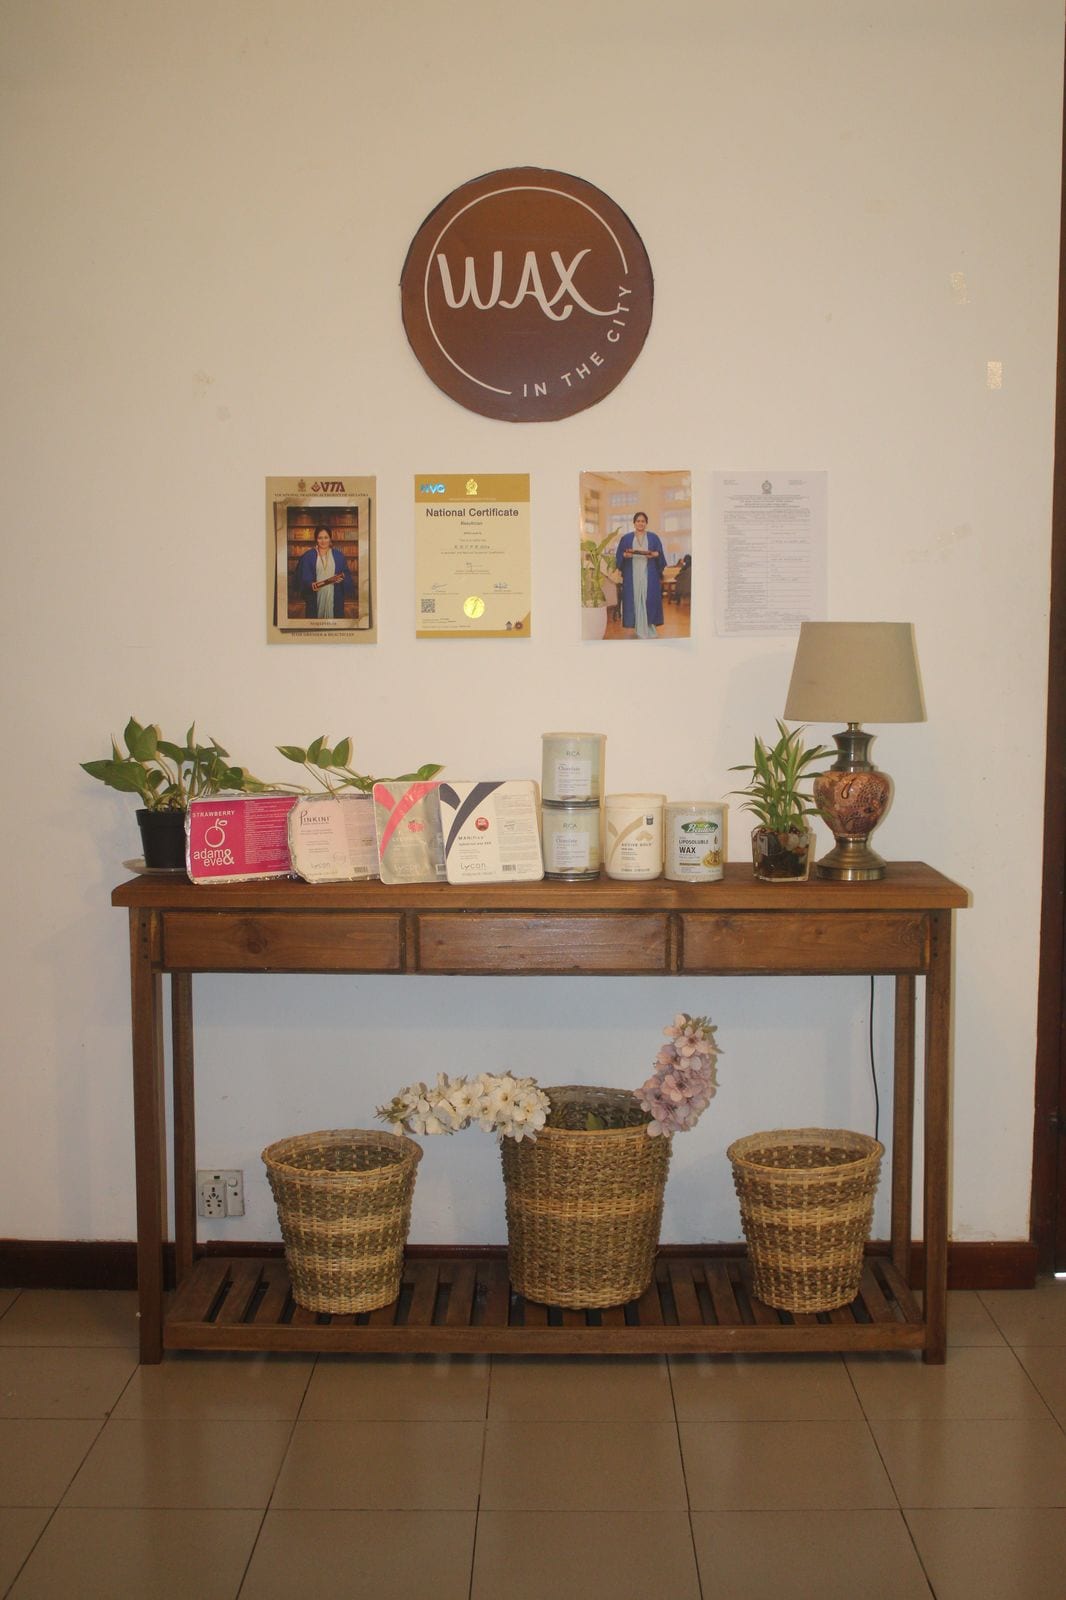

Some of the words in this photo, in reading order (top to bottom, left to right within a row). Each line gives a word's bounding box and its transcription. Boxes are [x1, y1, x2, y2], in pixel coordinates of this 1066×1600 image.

[437, 249, 620, 321] WAX
[522, 382, 547, 398] IN
[560, 351, 605, 388] THE
[606, 285, 633, 343] CITY
[426, 508, 466, 517] National
[468, 507, 519, 517] Certificate
[679, 846, 697, 854] WAX
